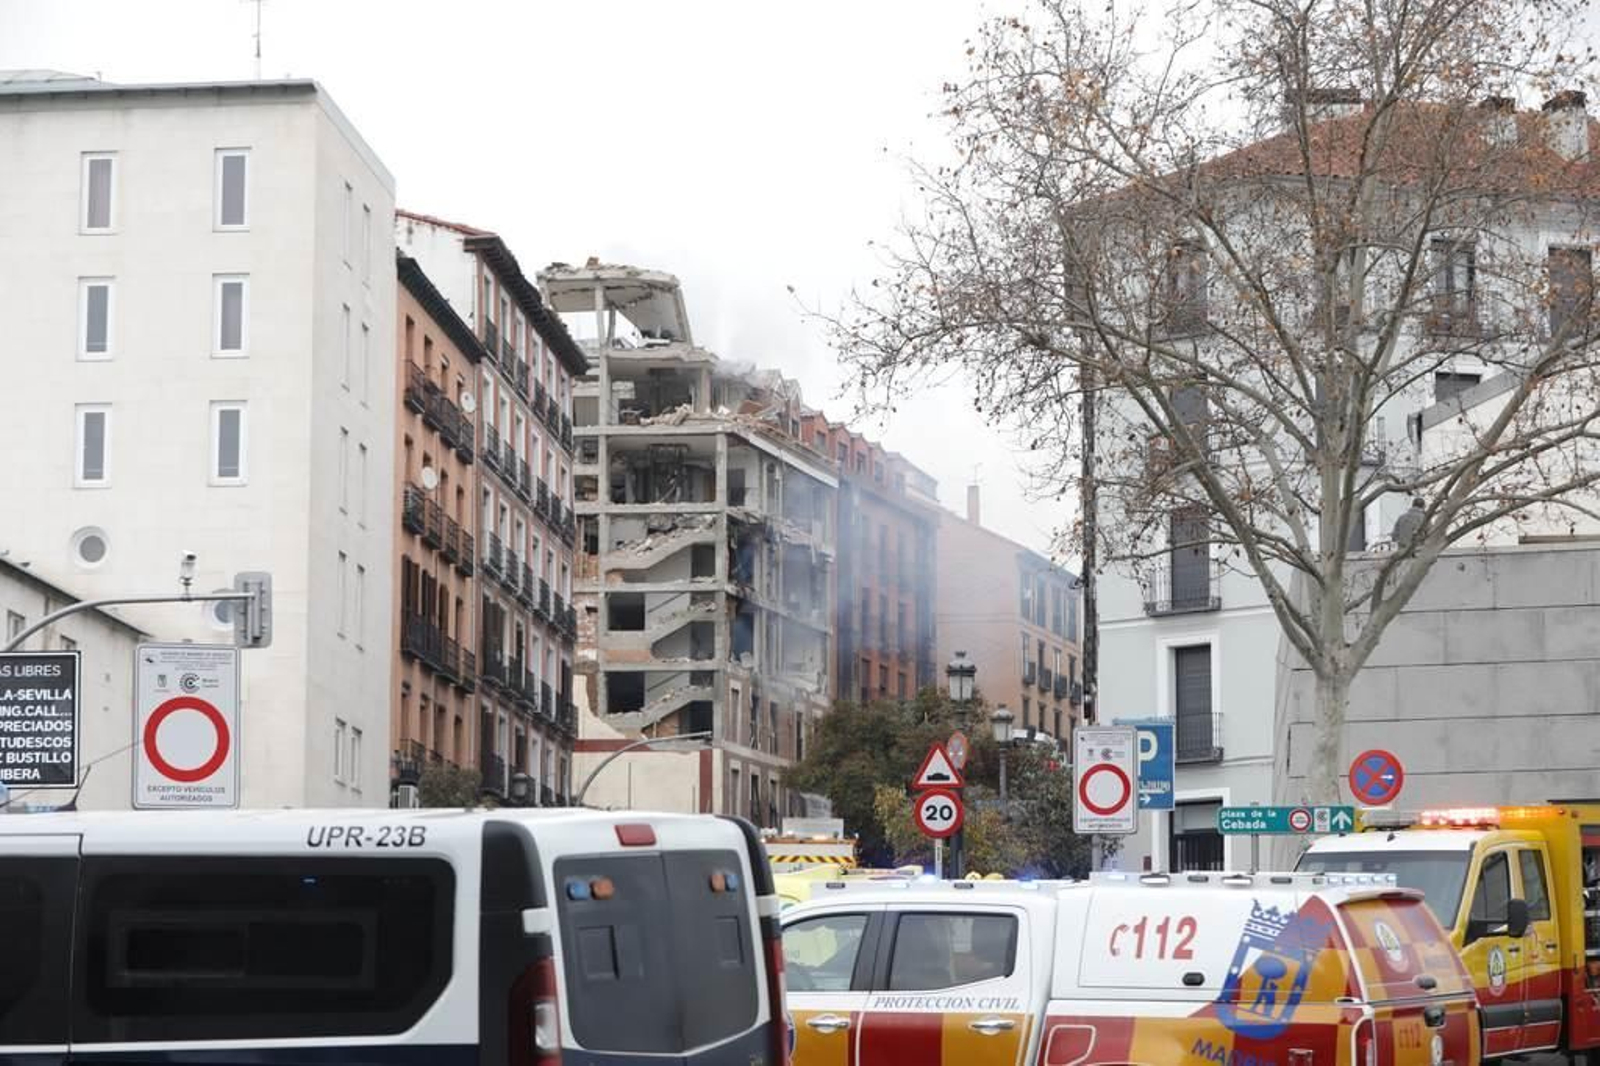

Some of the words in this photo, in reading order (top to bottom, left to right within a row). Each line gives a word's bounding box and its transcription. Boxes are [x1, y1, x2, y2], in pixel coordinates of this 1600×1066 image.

[0, 665, 12, 677] S
[14, 664, 61, 677] LIBRES
[0, 736, 72, 748] TUDESCOS
[6, 751, 72, 763] BUSTILLO
[1136, 730, 1158, 777] P
[160, 794, 213, 802] AUTORIZADOS
[925, 805, 953, 821] 20
[1221, 810, 1246, 819] plaza
[1222, 819, 1267, 829] Cebada
[307, 825, 426, 847] UPR-23B
[1133, 916, 1197, 960] 112
[977, 997, 1020, 1010] CIVIL
